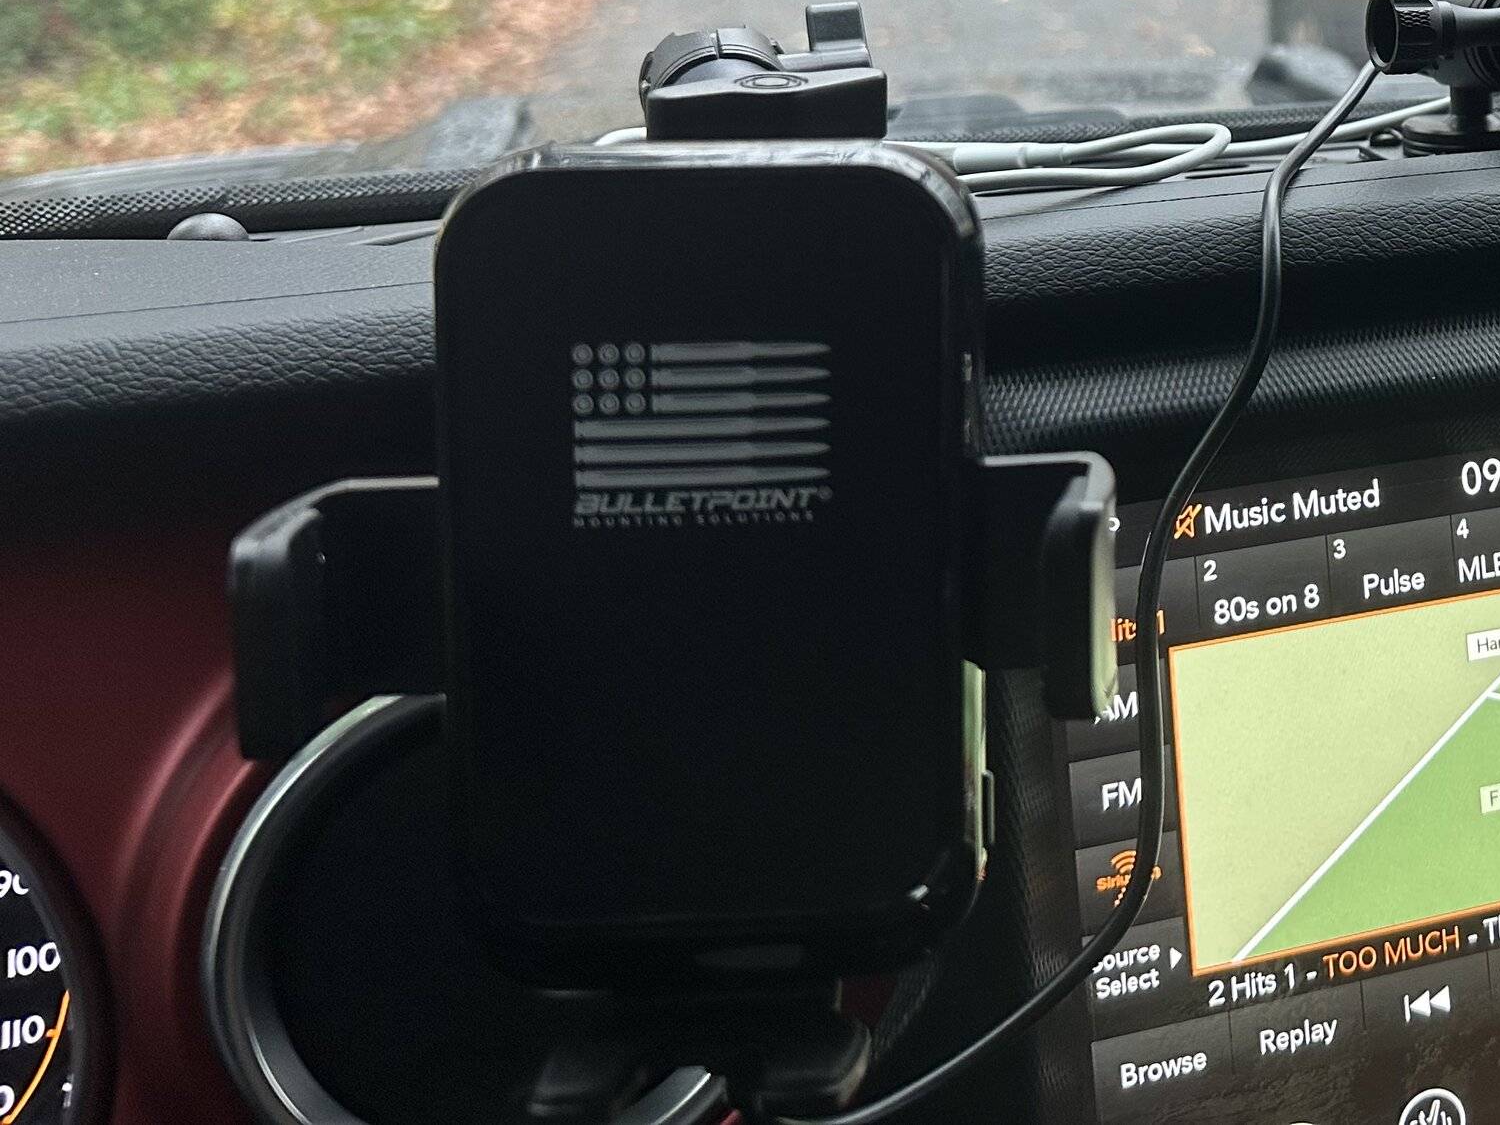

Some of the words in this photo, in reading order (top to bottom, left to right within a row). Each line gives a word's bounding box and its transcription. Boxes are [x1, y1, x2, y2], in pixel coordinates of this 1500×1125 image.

[697, 509, 814, 523] SOLUTIONS
[1204, 496, 1286, 535] Music
[1293, 478, 1381, 521] Muted
[1456, 518, 1470, 539] 4
[1332, 538, 1347, 560] 3
[1203, 560, 1218, 582] 2
[1363, 568, 1426, 599] Pulse
[1214, 595, 1260, 625] 80s
[1266, 591, 1298, 616] on
[1304, 583, 1320, 610] 8
[1101, 777, 1142, 813] FM
[7, 941, 61, 978] 100
[1208, 980, 1226, 1007] 2
[1231, 972, 1277, 1002] Hits
[1284, 964, 1296, 989] 1
[1322, 945, 1377, 979] TOO
[1385, 926, 1461, 967] MUCH
[1096, 968, 1161, 1000] Select
[0, 1014, 46, 1051] 110
[1259, 1019, 1339, 1056] Replay
[1120, 1051, 1208, 1089] Browse
